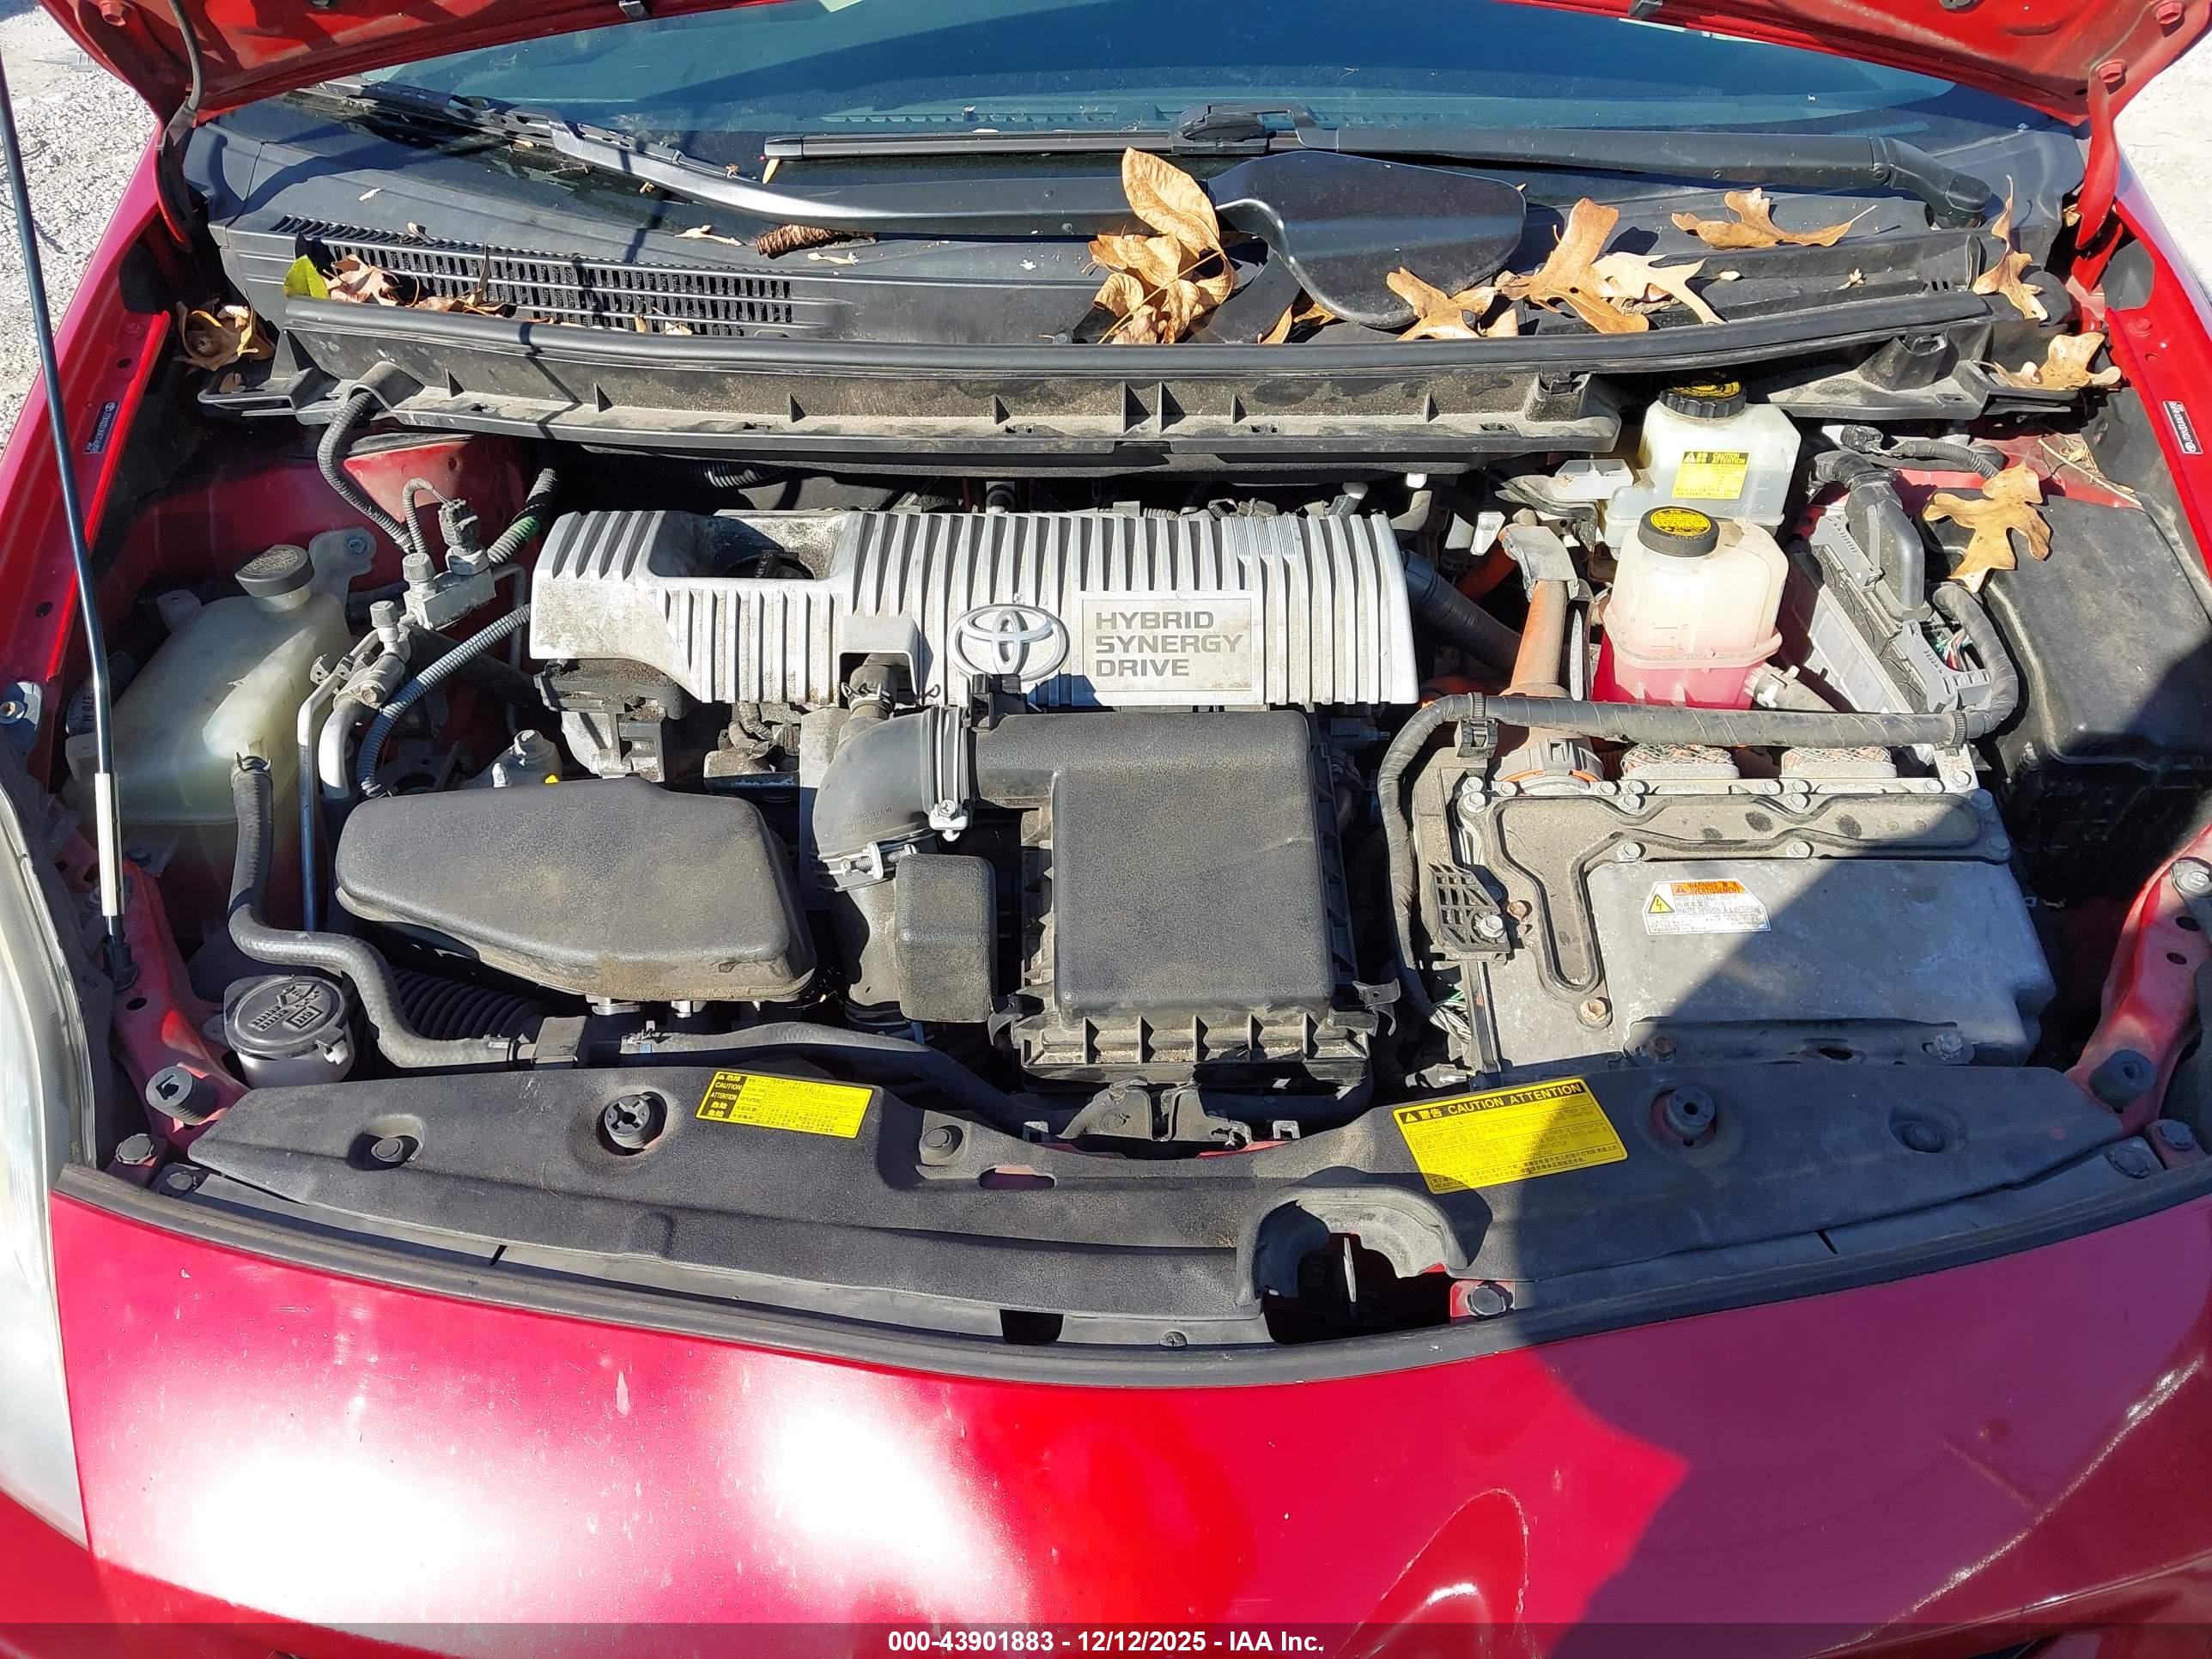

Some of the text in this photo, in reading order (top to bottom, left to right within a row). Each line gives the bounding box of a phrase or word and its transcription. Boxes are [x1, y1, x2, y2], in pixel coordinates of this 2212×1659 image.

[1096, 611, 1214, 630] HYBRID
[1096, 635, 1243, 653] SYNERGY
[1096, 659, 1190, 678] DRIVE
[1687, 881, 1718, 890] WARNING
[714, 1081, 743, 1091] CAUTION
[709, 1091, 738, 1101] ATTENTION
[1448, 1097, 1504, 1115] CAUTION
[1510, 1083, 1582, 1105] ATTENTION
